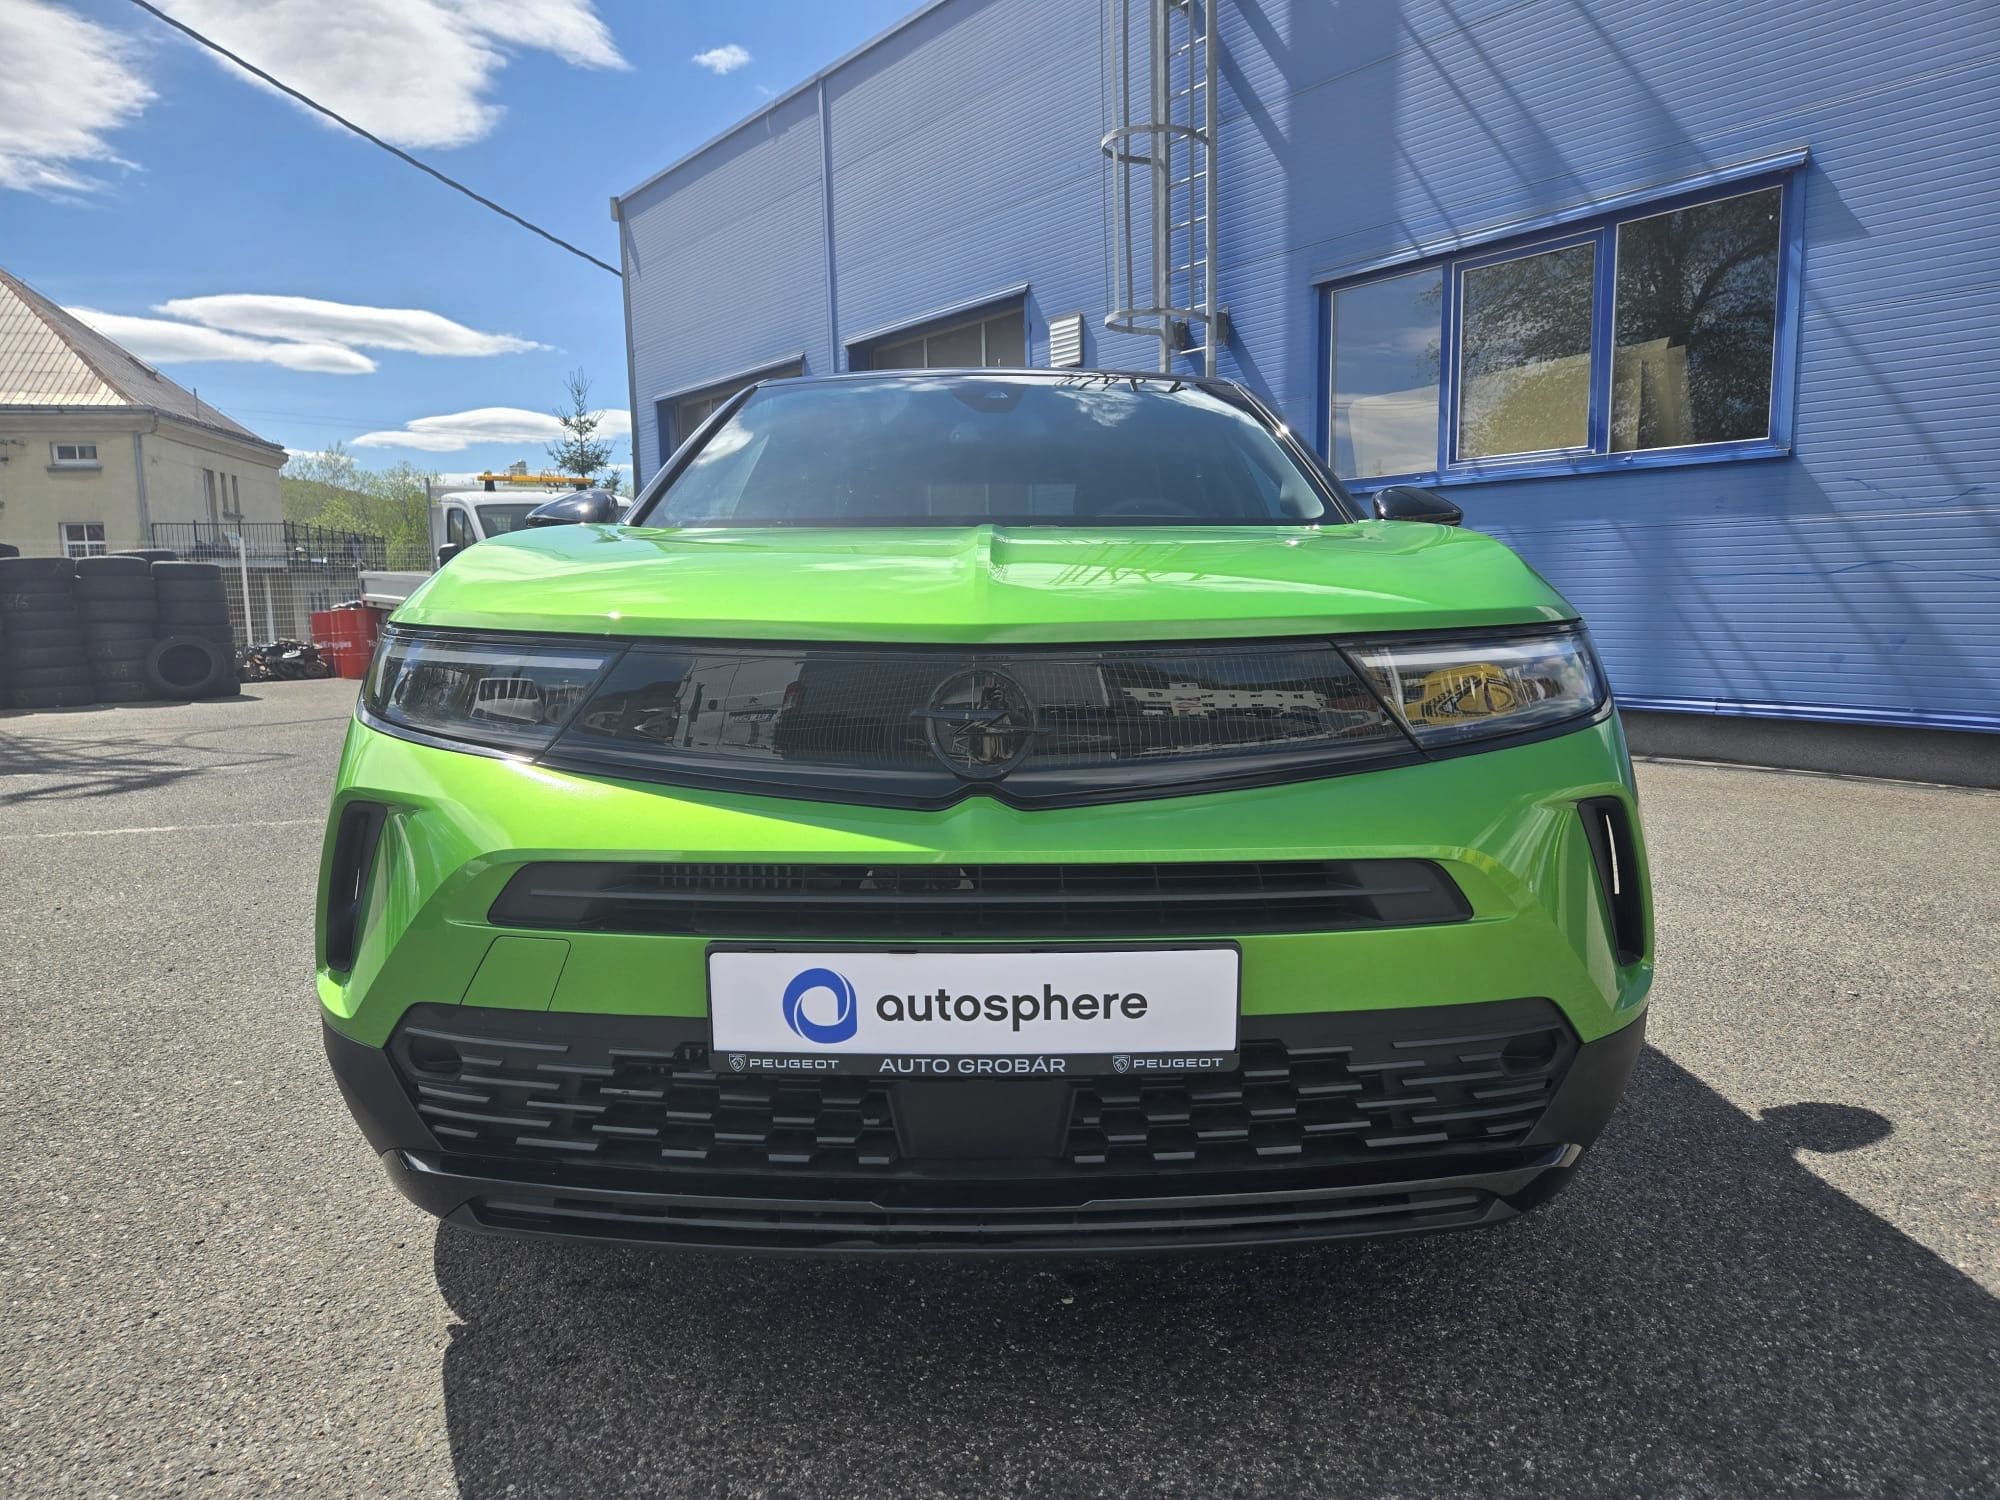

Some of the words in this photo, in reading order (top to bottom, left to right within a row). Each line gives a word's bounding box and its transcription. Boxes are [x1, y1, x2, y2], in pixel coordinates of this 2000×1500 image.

[876, 984, 1148, 1032] autosphere
[749, 1058, 839, 1069] PEUGEOT
[879, 1058, 950, 1073] AUTO
[957, 1056, 1066, 1073] GROBÁR
[1133, 1057, 1223, 1069] PEUGEOT
